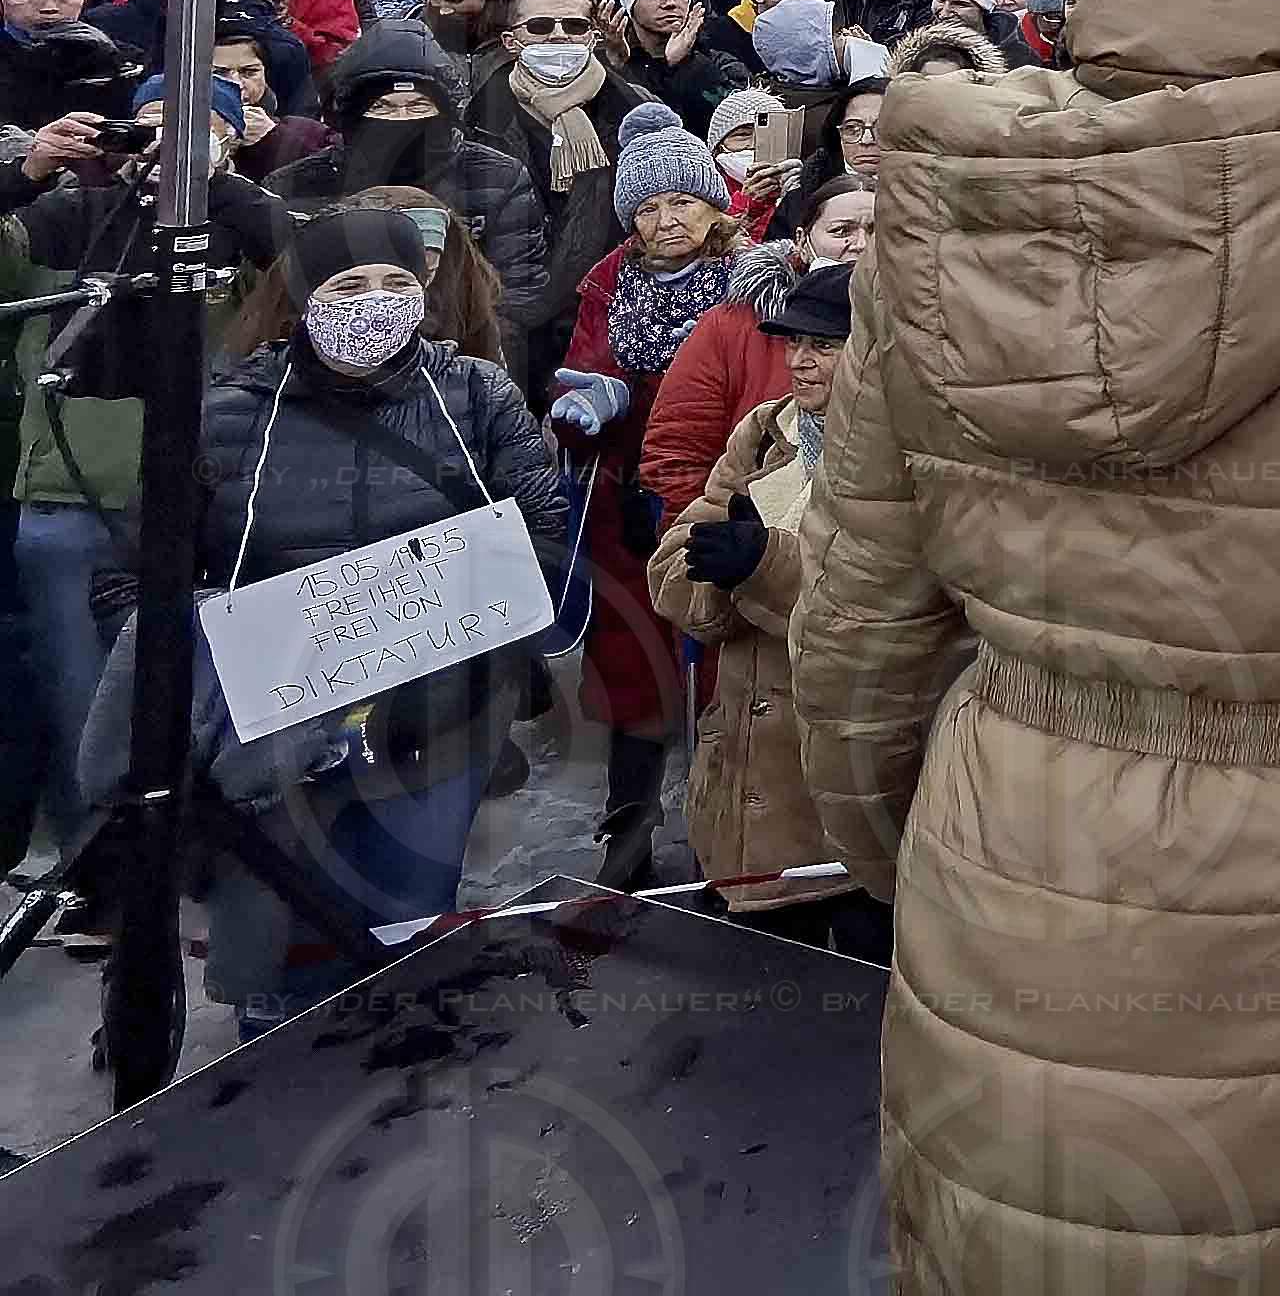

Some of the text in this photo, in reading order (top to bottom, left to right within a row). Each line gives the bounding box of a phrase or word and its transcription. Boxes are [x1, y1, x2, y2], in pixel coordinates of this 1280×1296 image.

[302, 558, 449, 627] FREIHEIT
[309, 589, 443, 653] FREI VON
[269, 613, 486, 711] DIKTATUR
